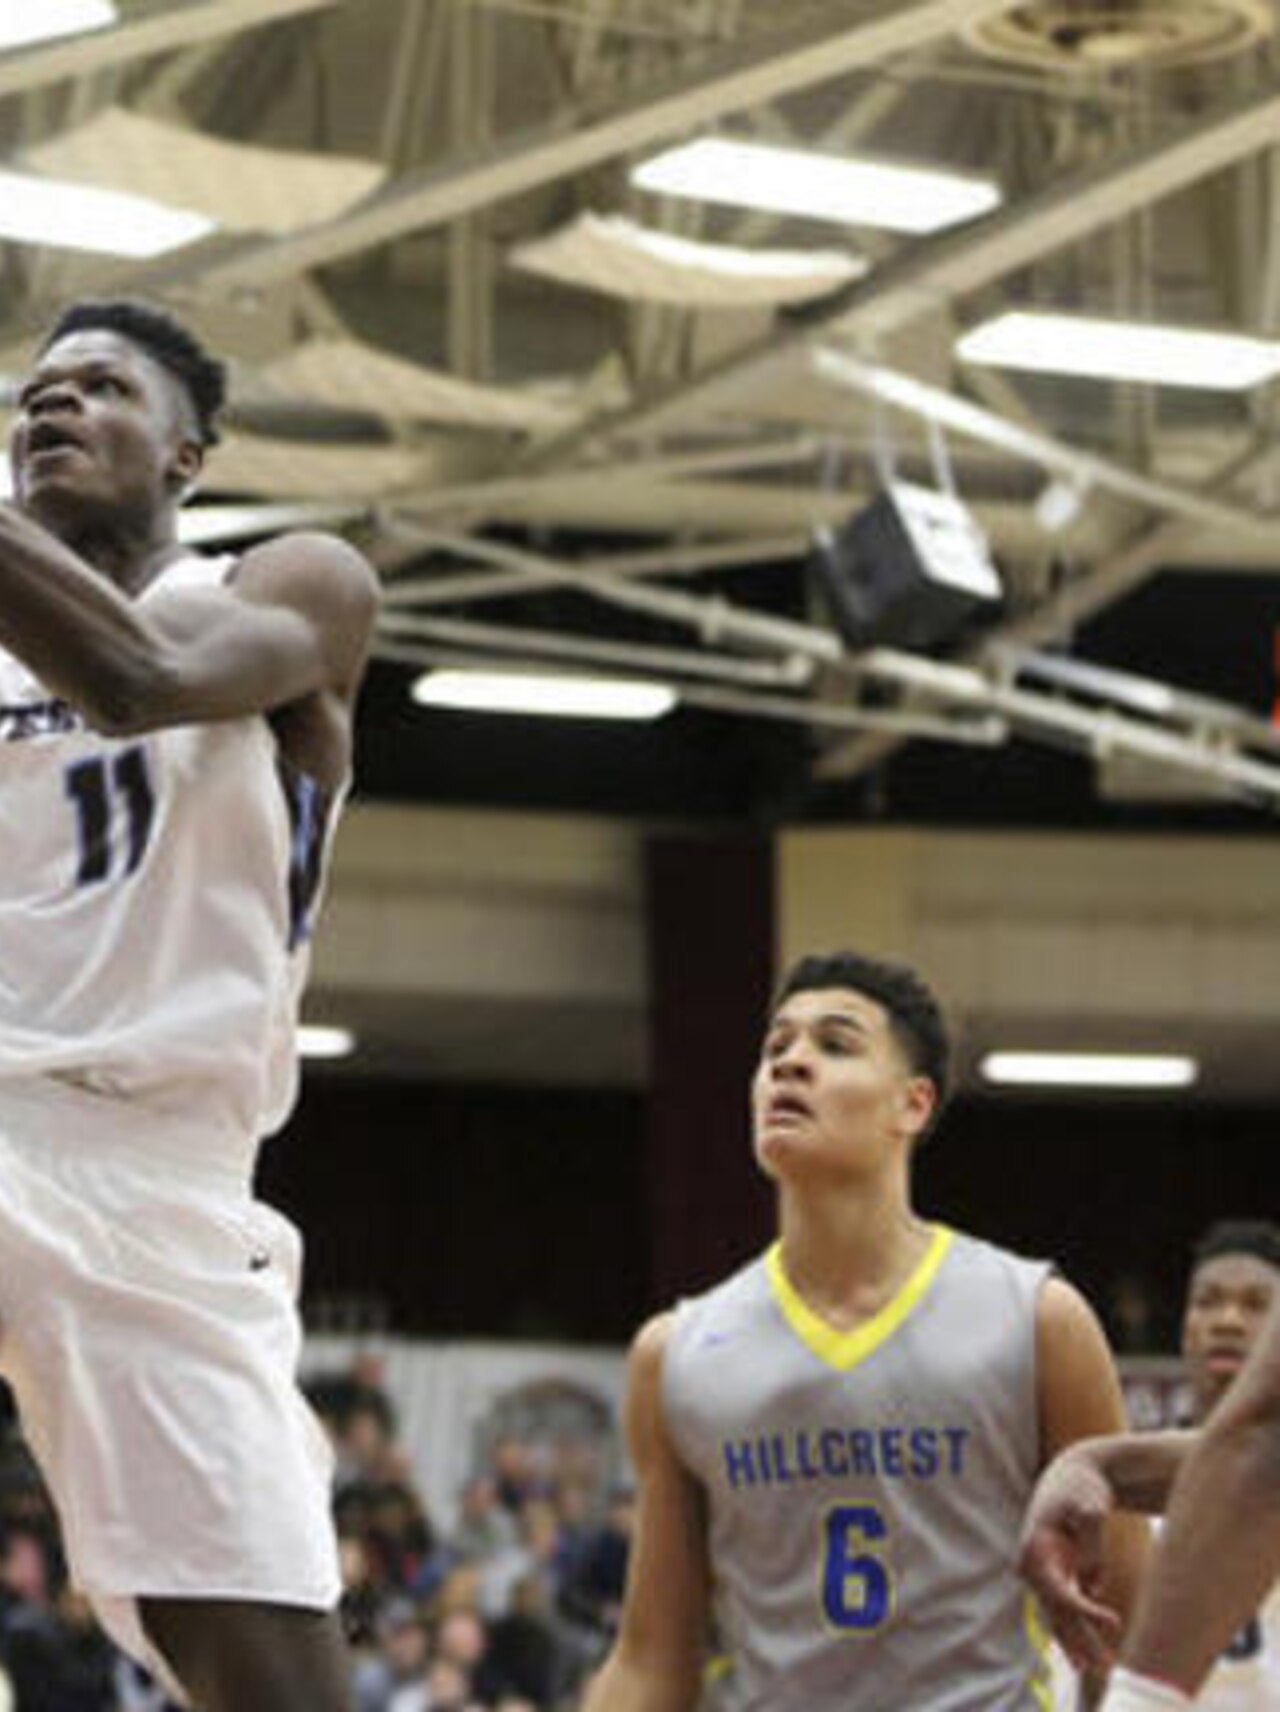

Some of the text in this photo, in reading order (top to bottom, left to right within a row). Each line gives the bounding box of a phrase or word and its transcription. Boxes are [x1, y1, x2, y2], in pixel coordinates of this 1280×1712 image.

[65, 743, 155, 887] 11
[723, 1426, 970, 1488] HILLCREST
[820, 1502, 893, 1633] 6
